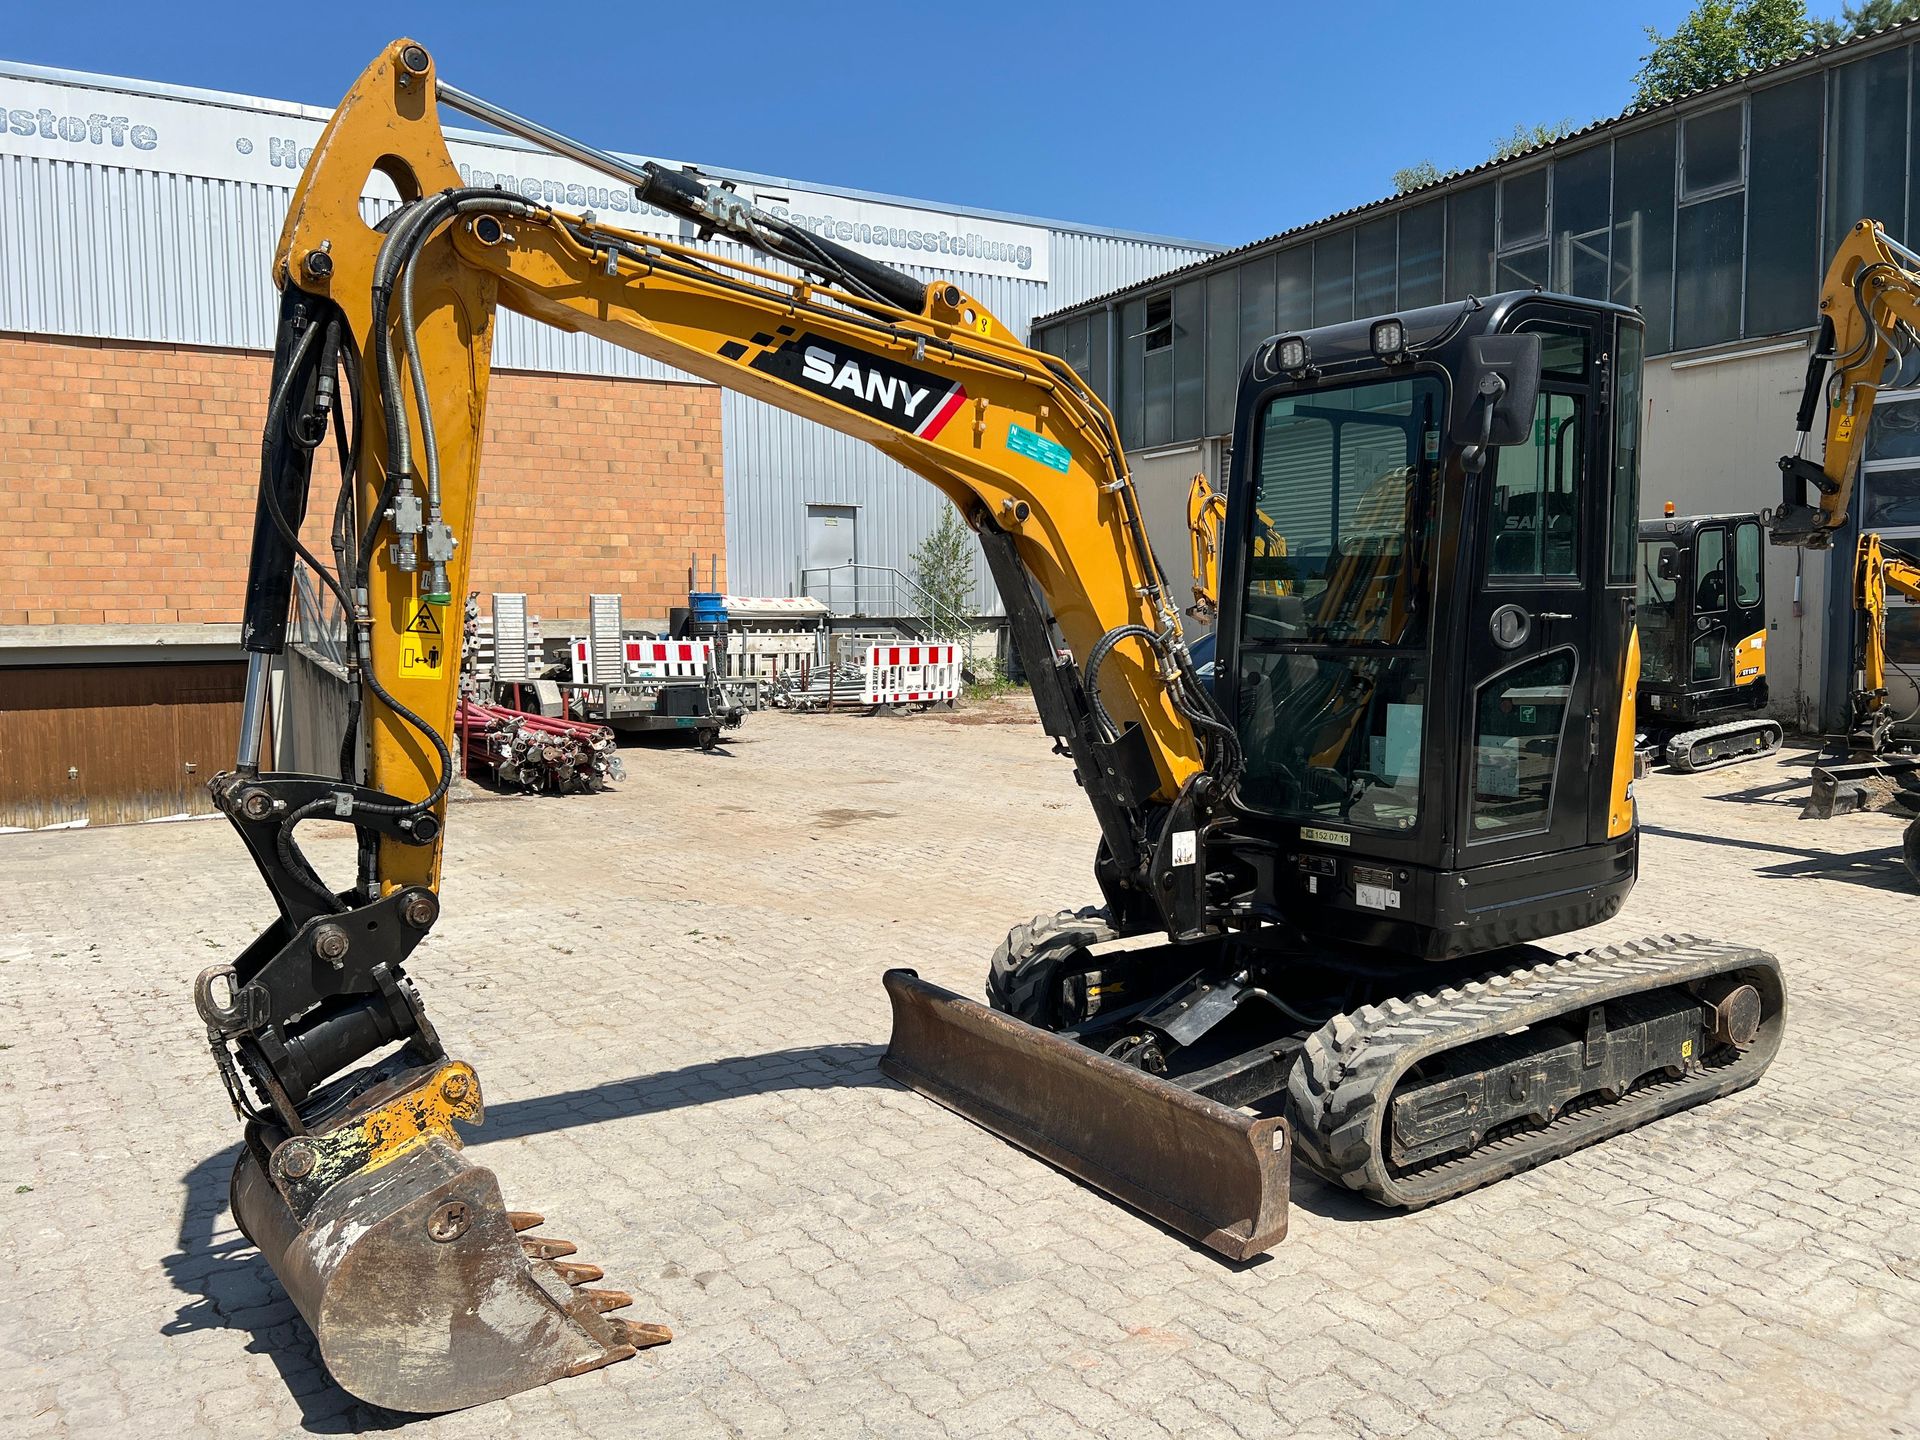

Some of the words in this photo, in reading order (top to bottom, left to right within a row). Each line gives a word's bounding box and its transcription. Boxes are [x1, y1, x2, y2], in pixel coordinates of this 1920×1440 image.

[0, 107, 158, 150] stoffe
[802, 345, 930, 418] SANY
[1315, 831, 1328, 840] 152
[1329, 833, 1338, 841] 07
[1341, 835, 1350, 843] 13
